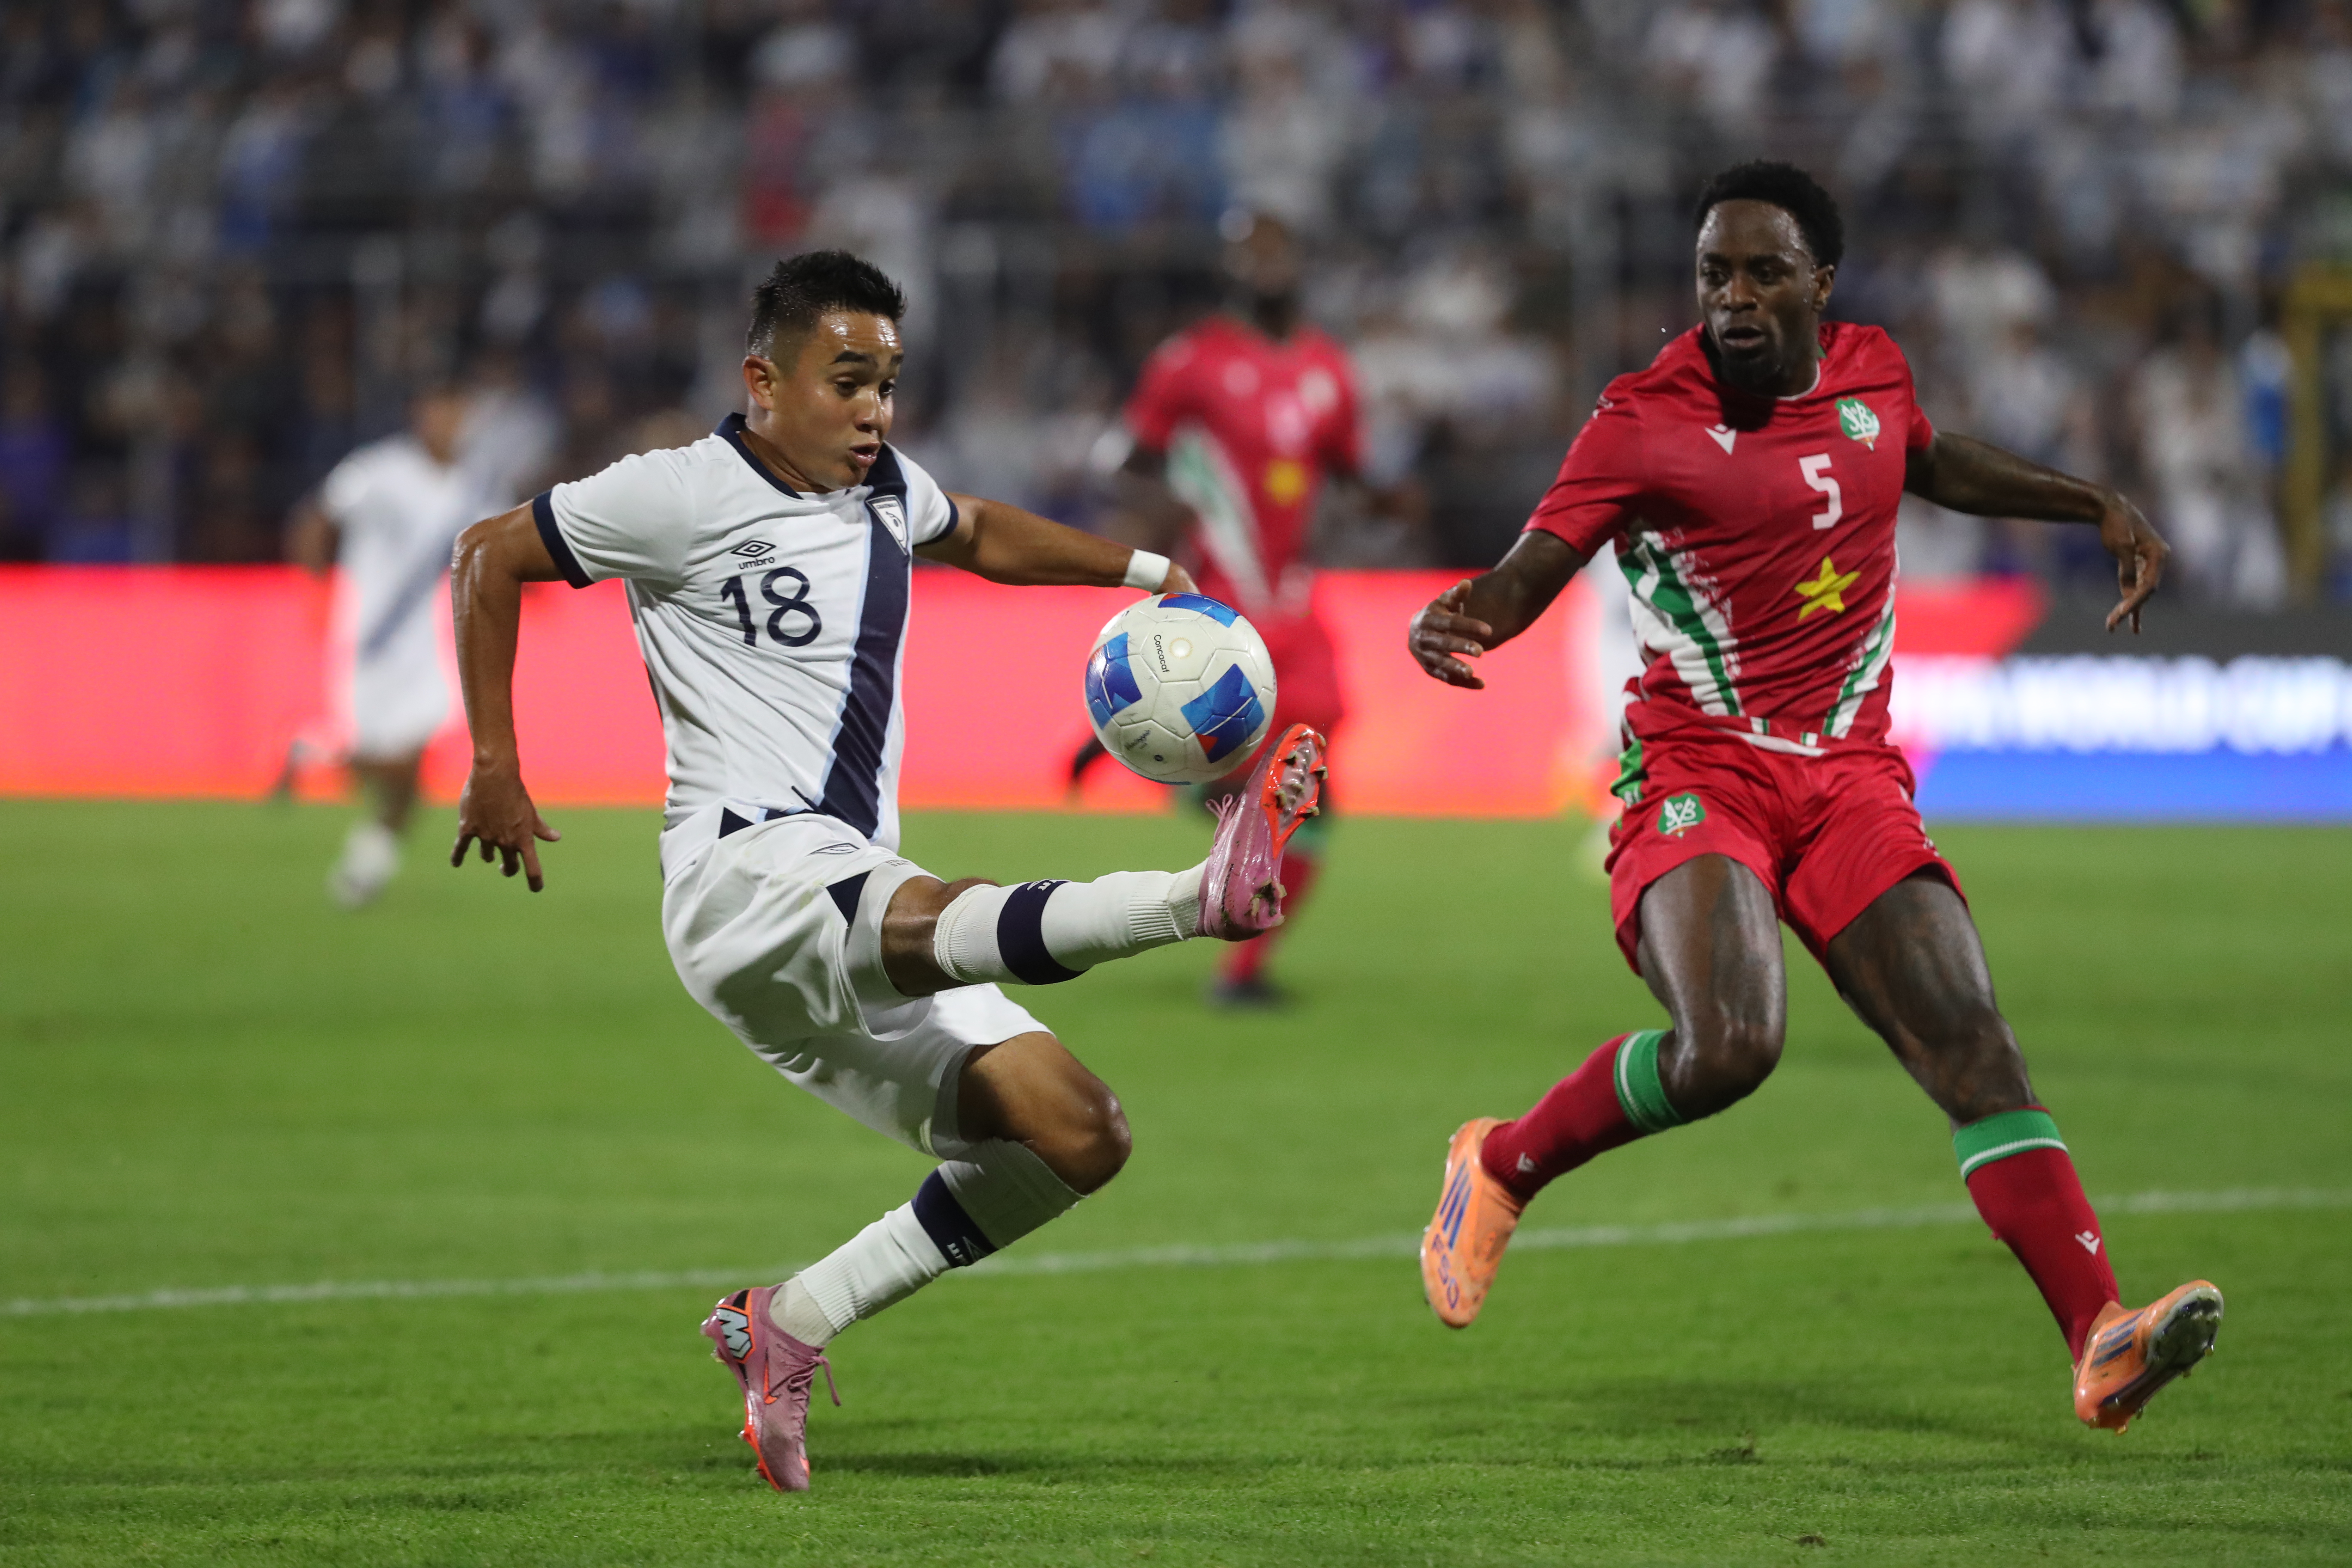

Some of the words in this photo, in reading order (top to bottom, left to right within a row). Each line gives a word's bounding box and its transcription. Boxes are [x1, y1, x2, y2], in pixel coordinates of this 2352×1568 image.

[1798, 453, 1843, 530] 5
[738, 557, 775, 570] umbro
[720, 567, 822, 647] 18
[1154, 634, 1170, 673] Concacaf
